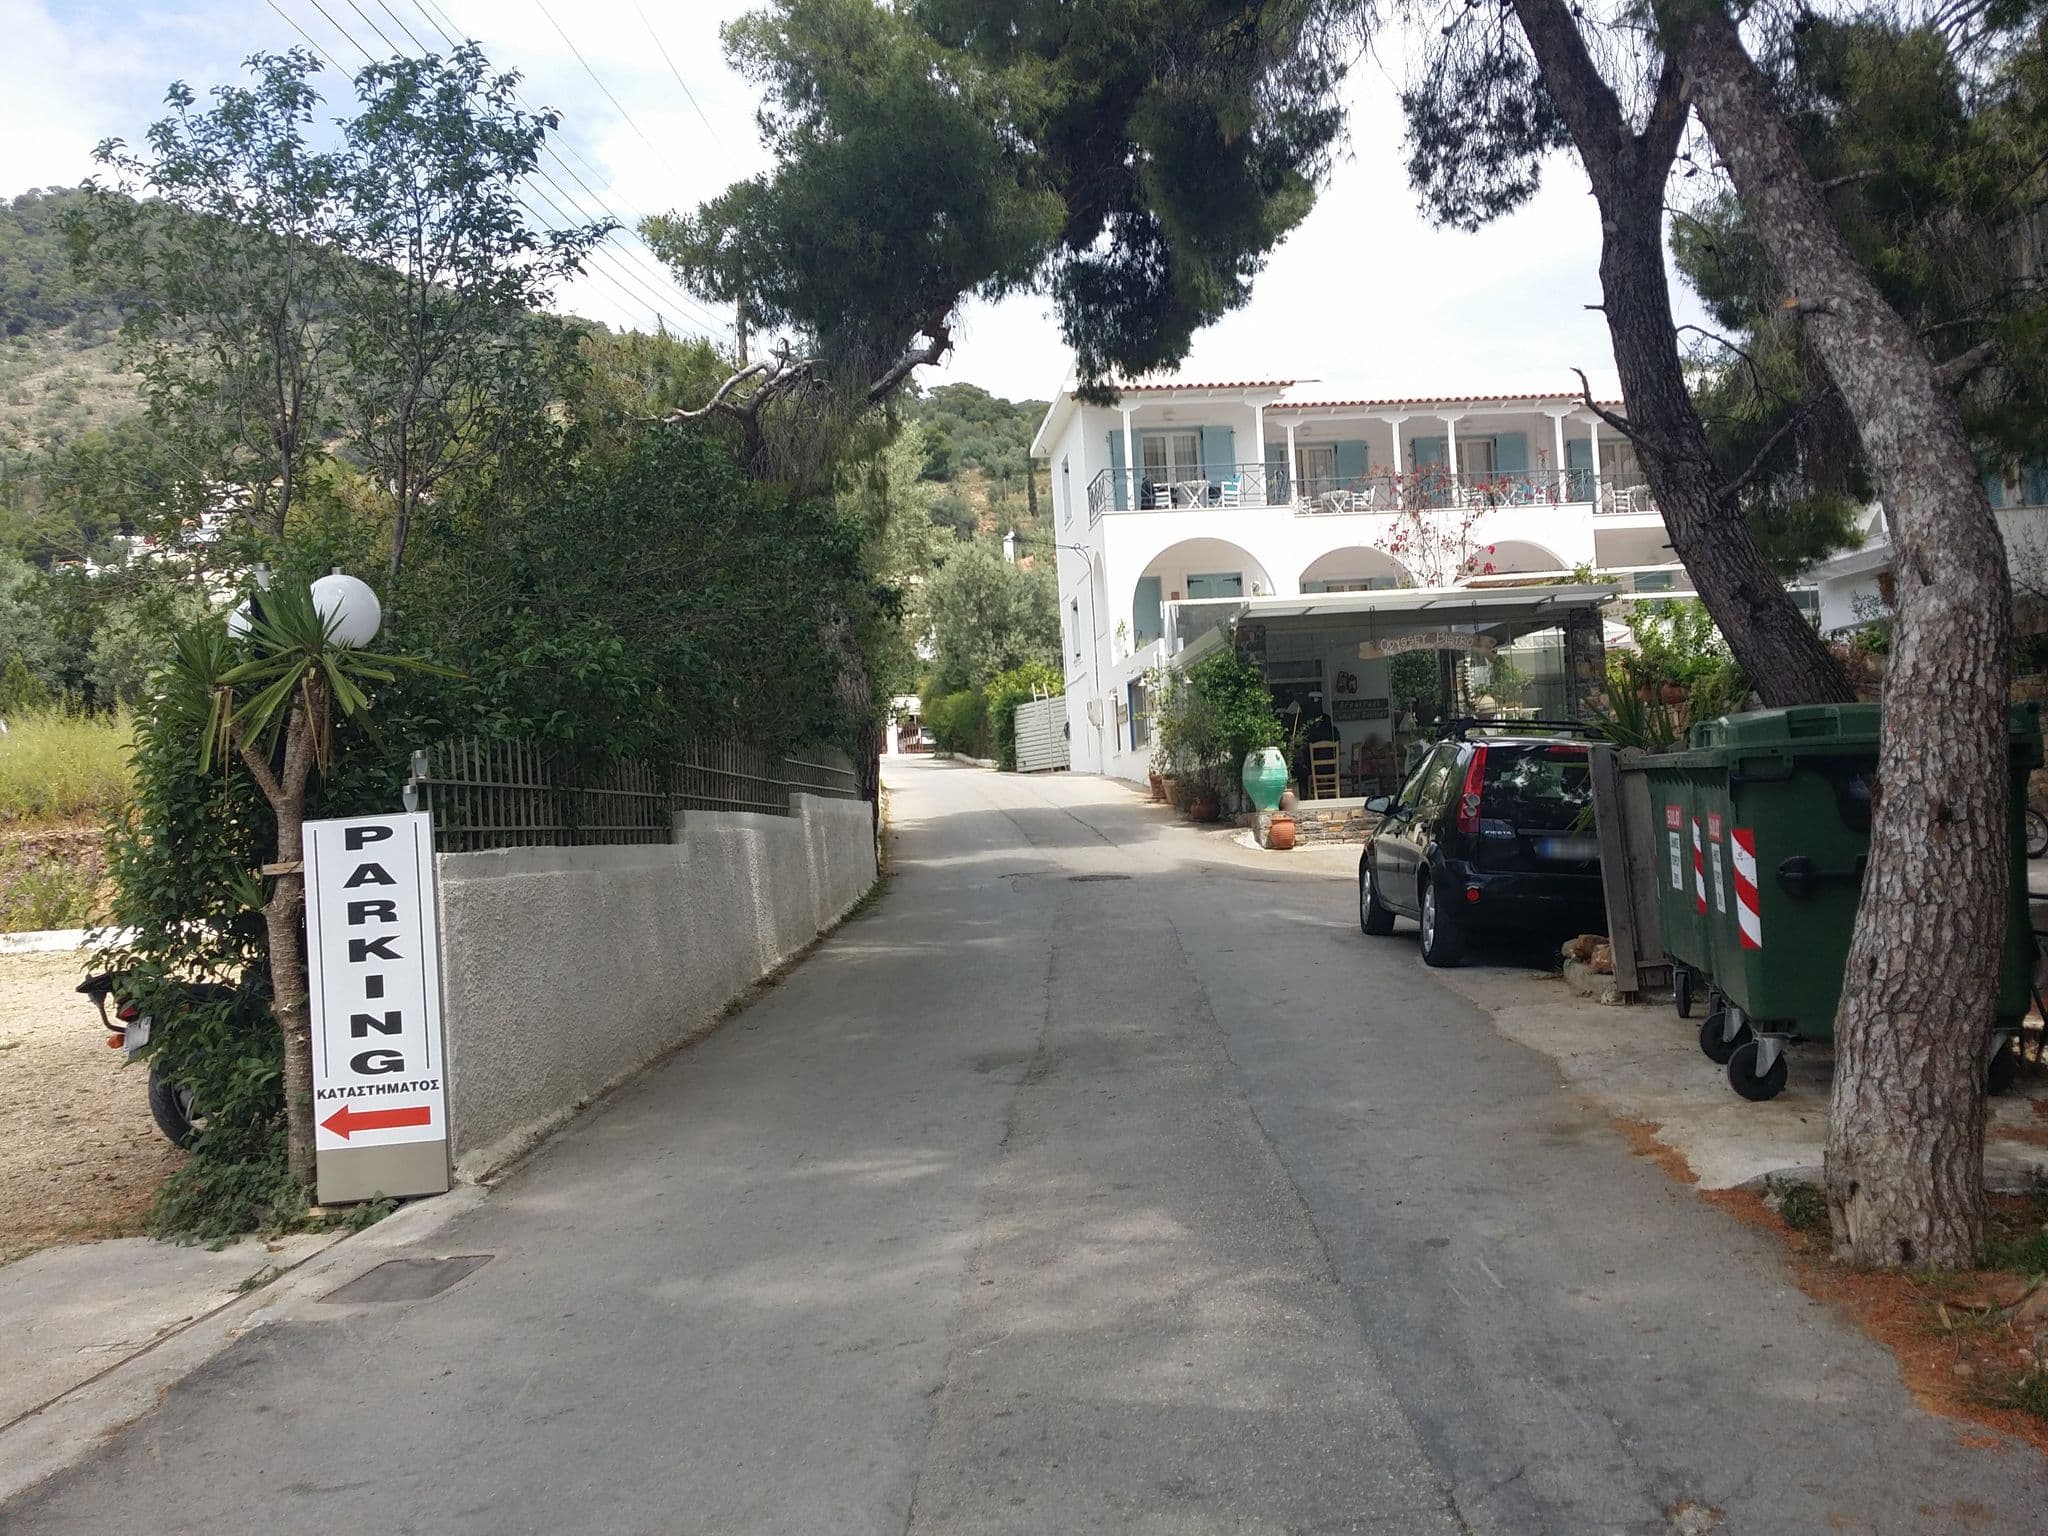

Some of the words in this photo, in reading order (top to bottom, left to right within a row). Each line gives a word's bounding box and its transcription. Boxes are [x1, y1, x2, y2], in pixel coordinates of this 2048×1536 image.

[1381, 634, 1427, 651] ODYSSEY
[1437, 631, 1474, 646] BISTRO
[343, 826, 405, 1075] PARKING
[317, 1079, 440, 1100] ΚΑΤΑΣΤΗΜΑΤΟΣ
